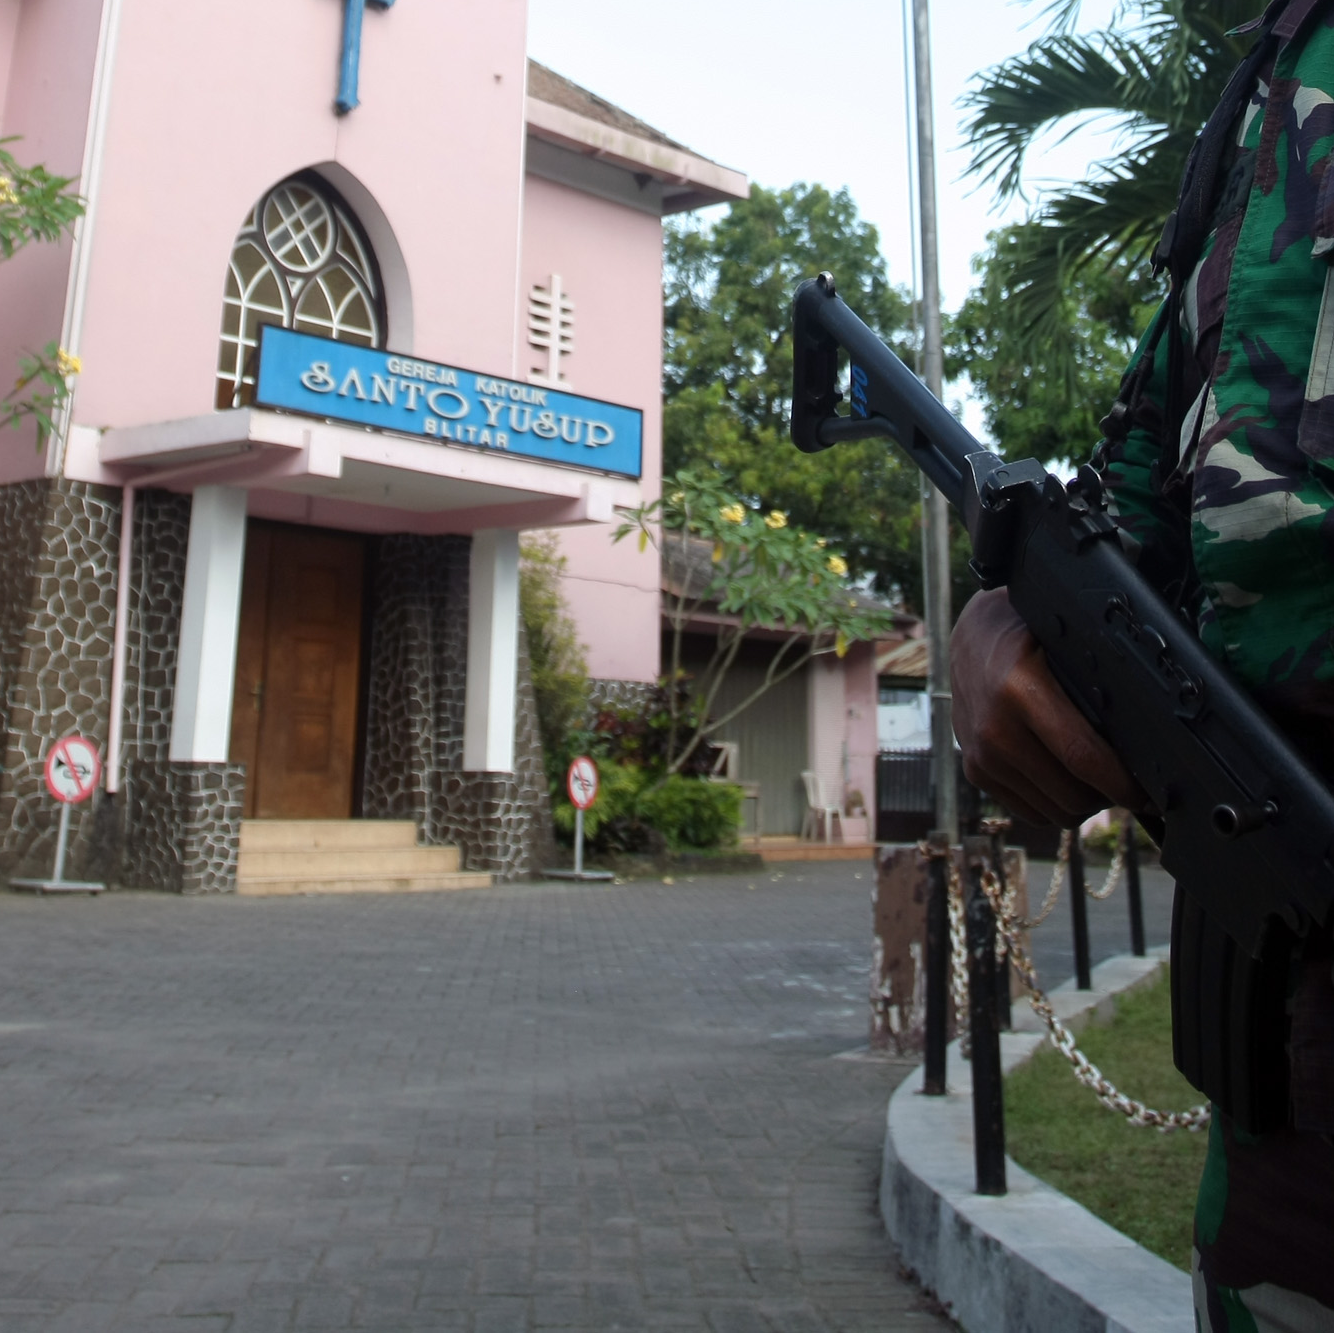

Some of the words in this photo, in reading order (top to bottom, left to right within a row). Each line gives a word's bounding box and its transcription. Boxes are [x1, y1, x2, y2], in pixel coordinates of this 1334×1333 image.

[300, 361, 470, 419] SANTO
[479, 397, 615, 448] YUSUP
[386, 356, 457, 387] GEREJA
[475, 376, 548, 407] KATOLIK
[424, 417, 509, 449] BLITAR
